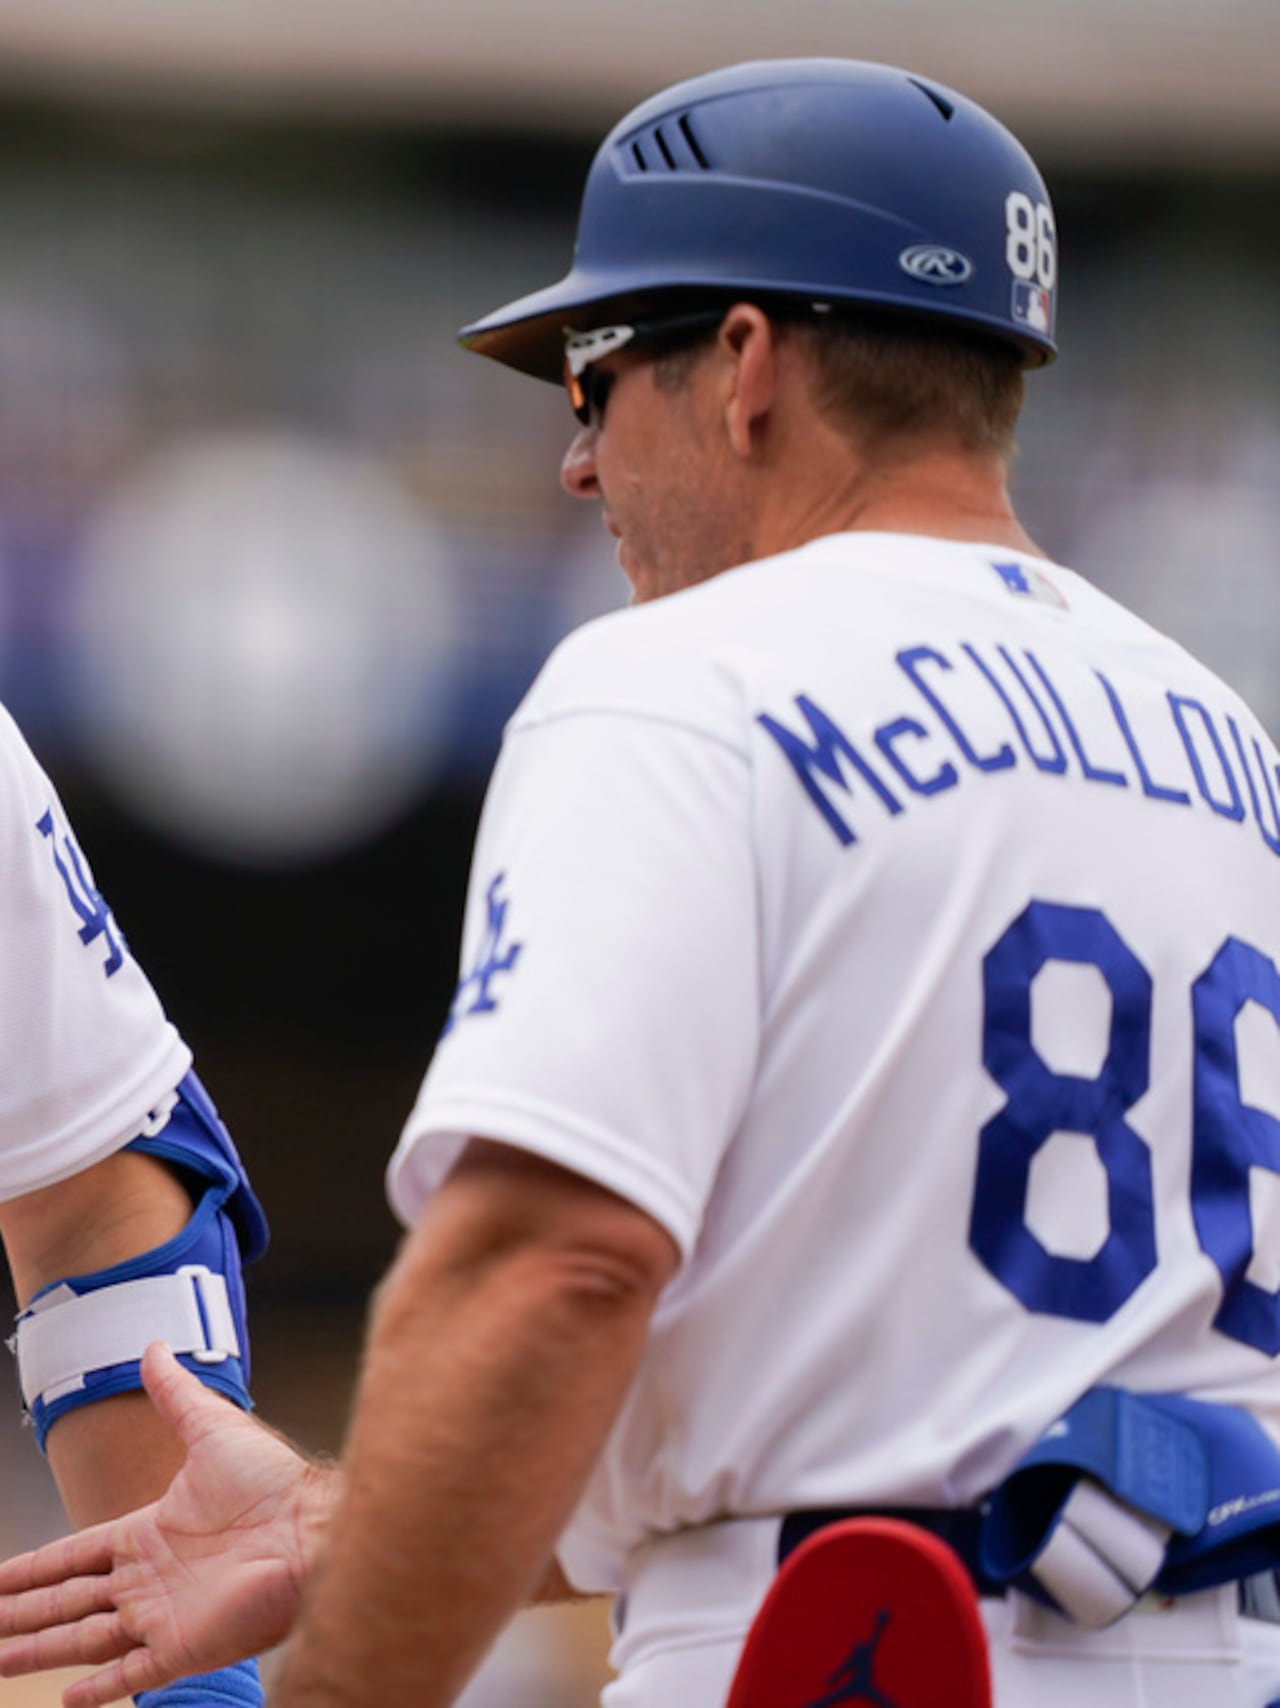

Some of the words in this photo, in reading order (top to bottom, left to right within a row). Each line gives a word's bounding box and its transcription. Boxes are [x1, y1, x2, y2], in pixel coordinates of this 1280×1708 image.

[1005, 190, 1055, 290] 86
[756, 642, 1280, 858] McCULLOU
[967, 898, 1280, 1360] 86
